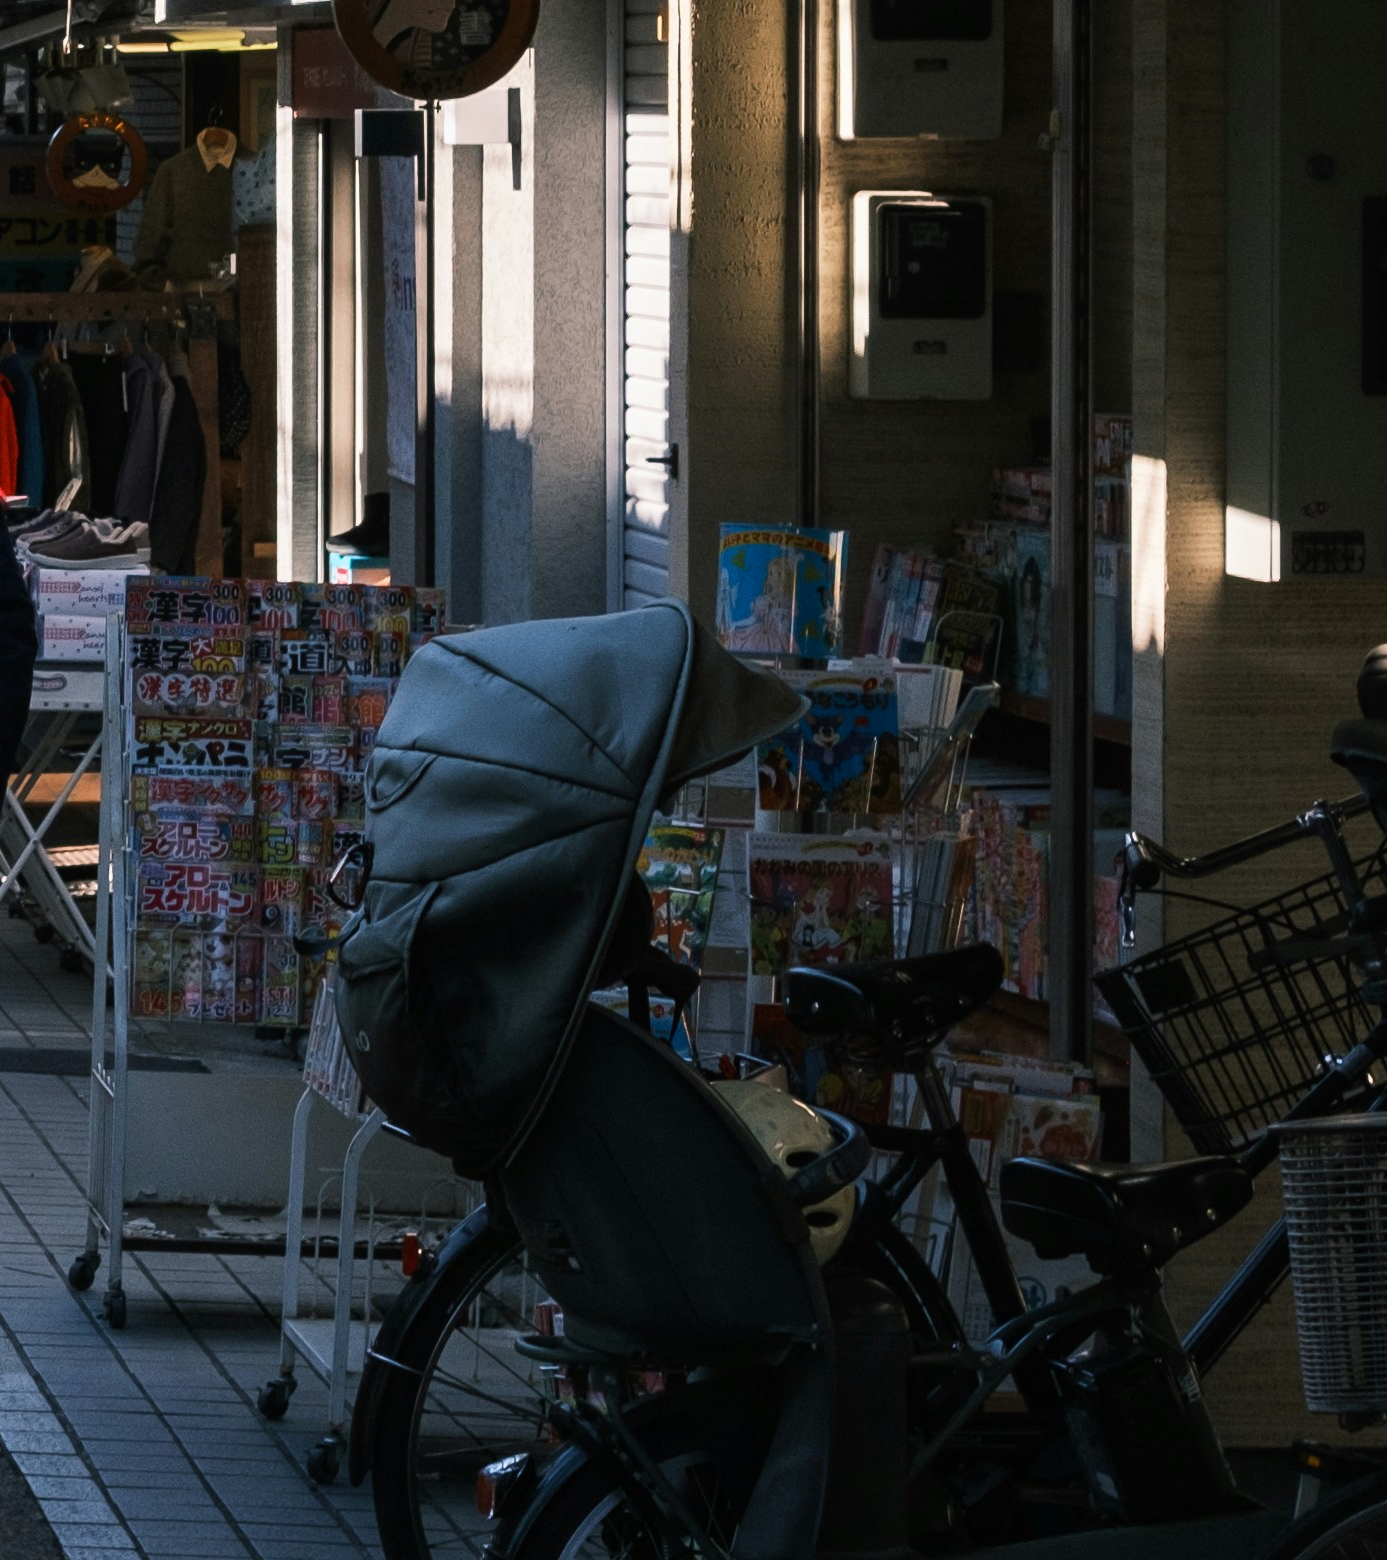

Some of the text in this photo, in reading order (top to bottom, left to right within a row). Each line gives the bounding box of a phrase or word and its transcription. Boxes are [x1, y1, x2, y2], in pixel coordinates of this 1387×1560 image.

[213, 585, 239, 600] 300
[266, 587, 293, 602] 300
[329, 589, 355, 604] 300
[380, 591, 405, 607] 300
[148, 590, 206, 623] 漢字
[341, 637, 368, 651] 300
[133, 639, 190, 670] 漢字
[141, 838, 228, 859] スケルトン
[164, 865, 231, 888] アロー
[142, 889, 253, 915] スケルトン
